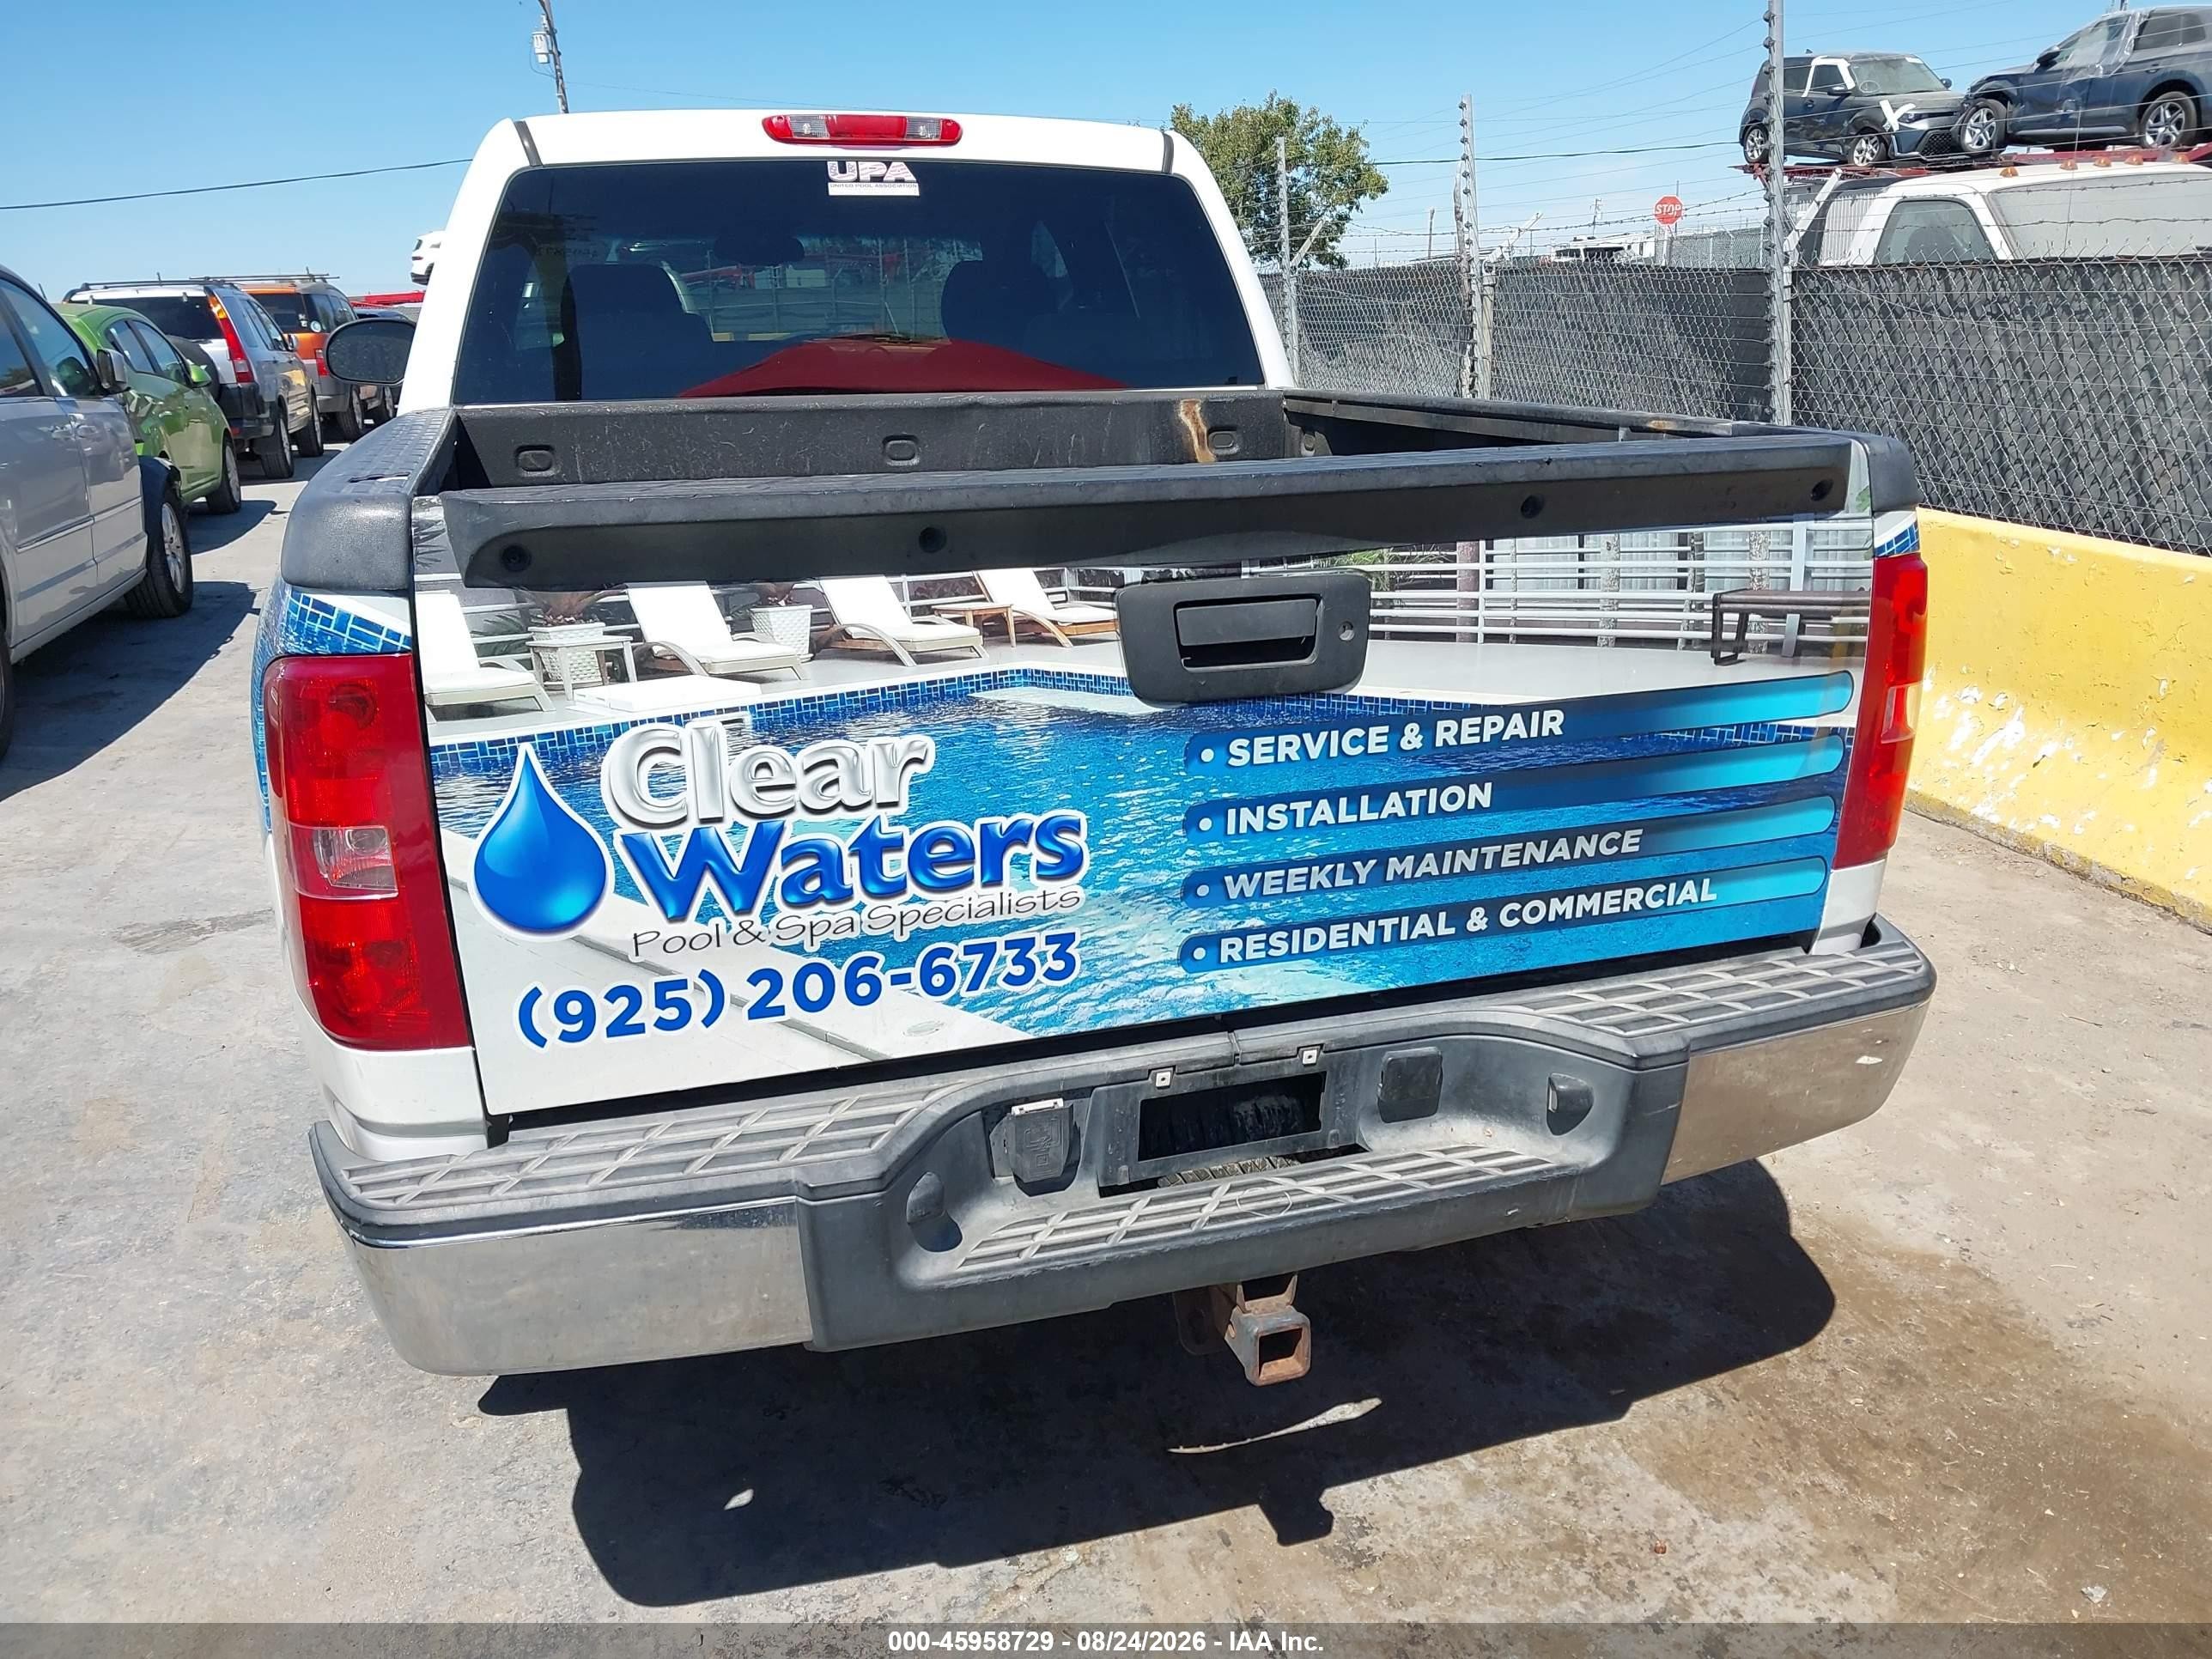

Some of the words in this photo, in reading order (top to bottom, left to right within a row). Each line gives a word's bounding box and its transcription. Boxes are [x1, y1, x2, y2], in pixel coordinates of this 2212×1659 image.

[827, 161, 916, 182] UPA
[1655, 204, 1682, 216] STOP
[1227, 725, 1389, 767] SERVICE
[1399, 722, 1424, 750] &
[1435, 709, 1565, 747] REPAIR
[608, 724, 930, 827] Clear
[1226, 781, 1493, 835] INSTALLATION
[620, 814, 1085, 924] Waters
[1224, 860, 1377, 900] WEEKLY
[1385, 829, 1644, 882] MAINTENANCE
[633, 923, 721, 957] Pool
[732, 920, 766, 945] &
[775, 915, 855, 947] Spa
[867, 890, 1081, 937] Specialists
[1219, 911, 1457, 963] RESIDENTIAL
[1469, 908, 1490, 933] &
[1498, 878, 1718, 927] COMMERCIAL
[518, 969, 725, 1048] (925)
[746, 932, 1078, 1021] 206-6733
